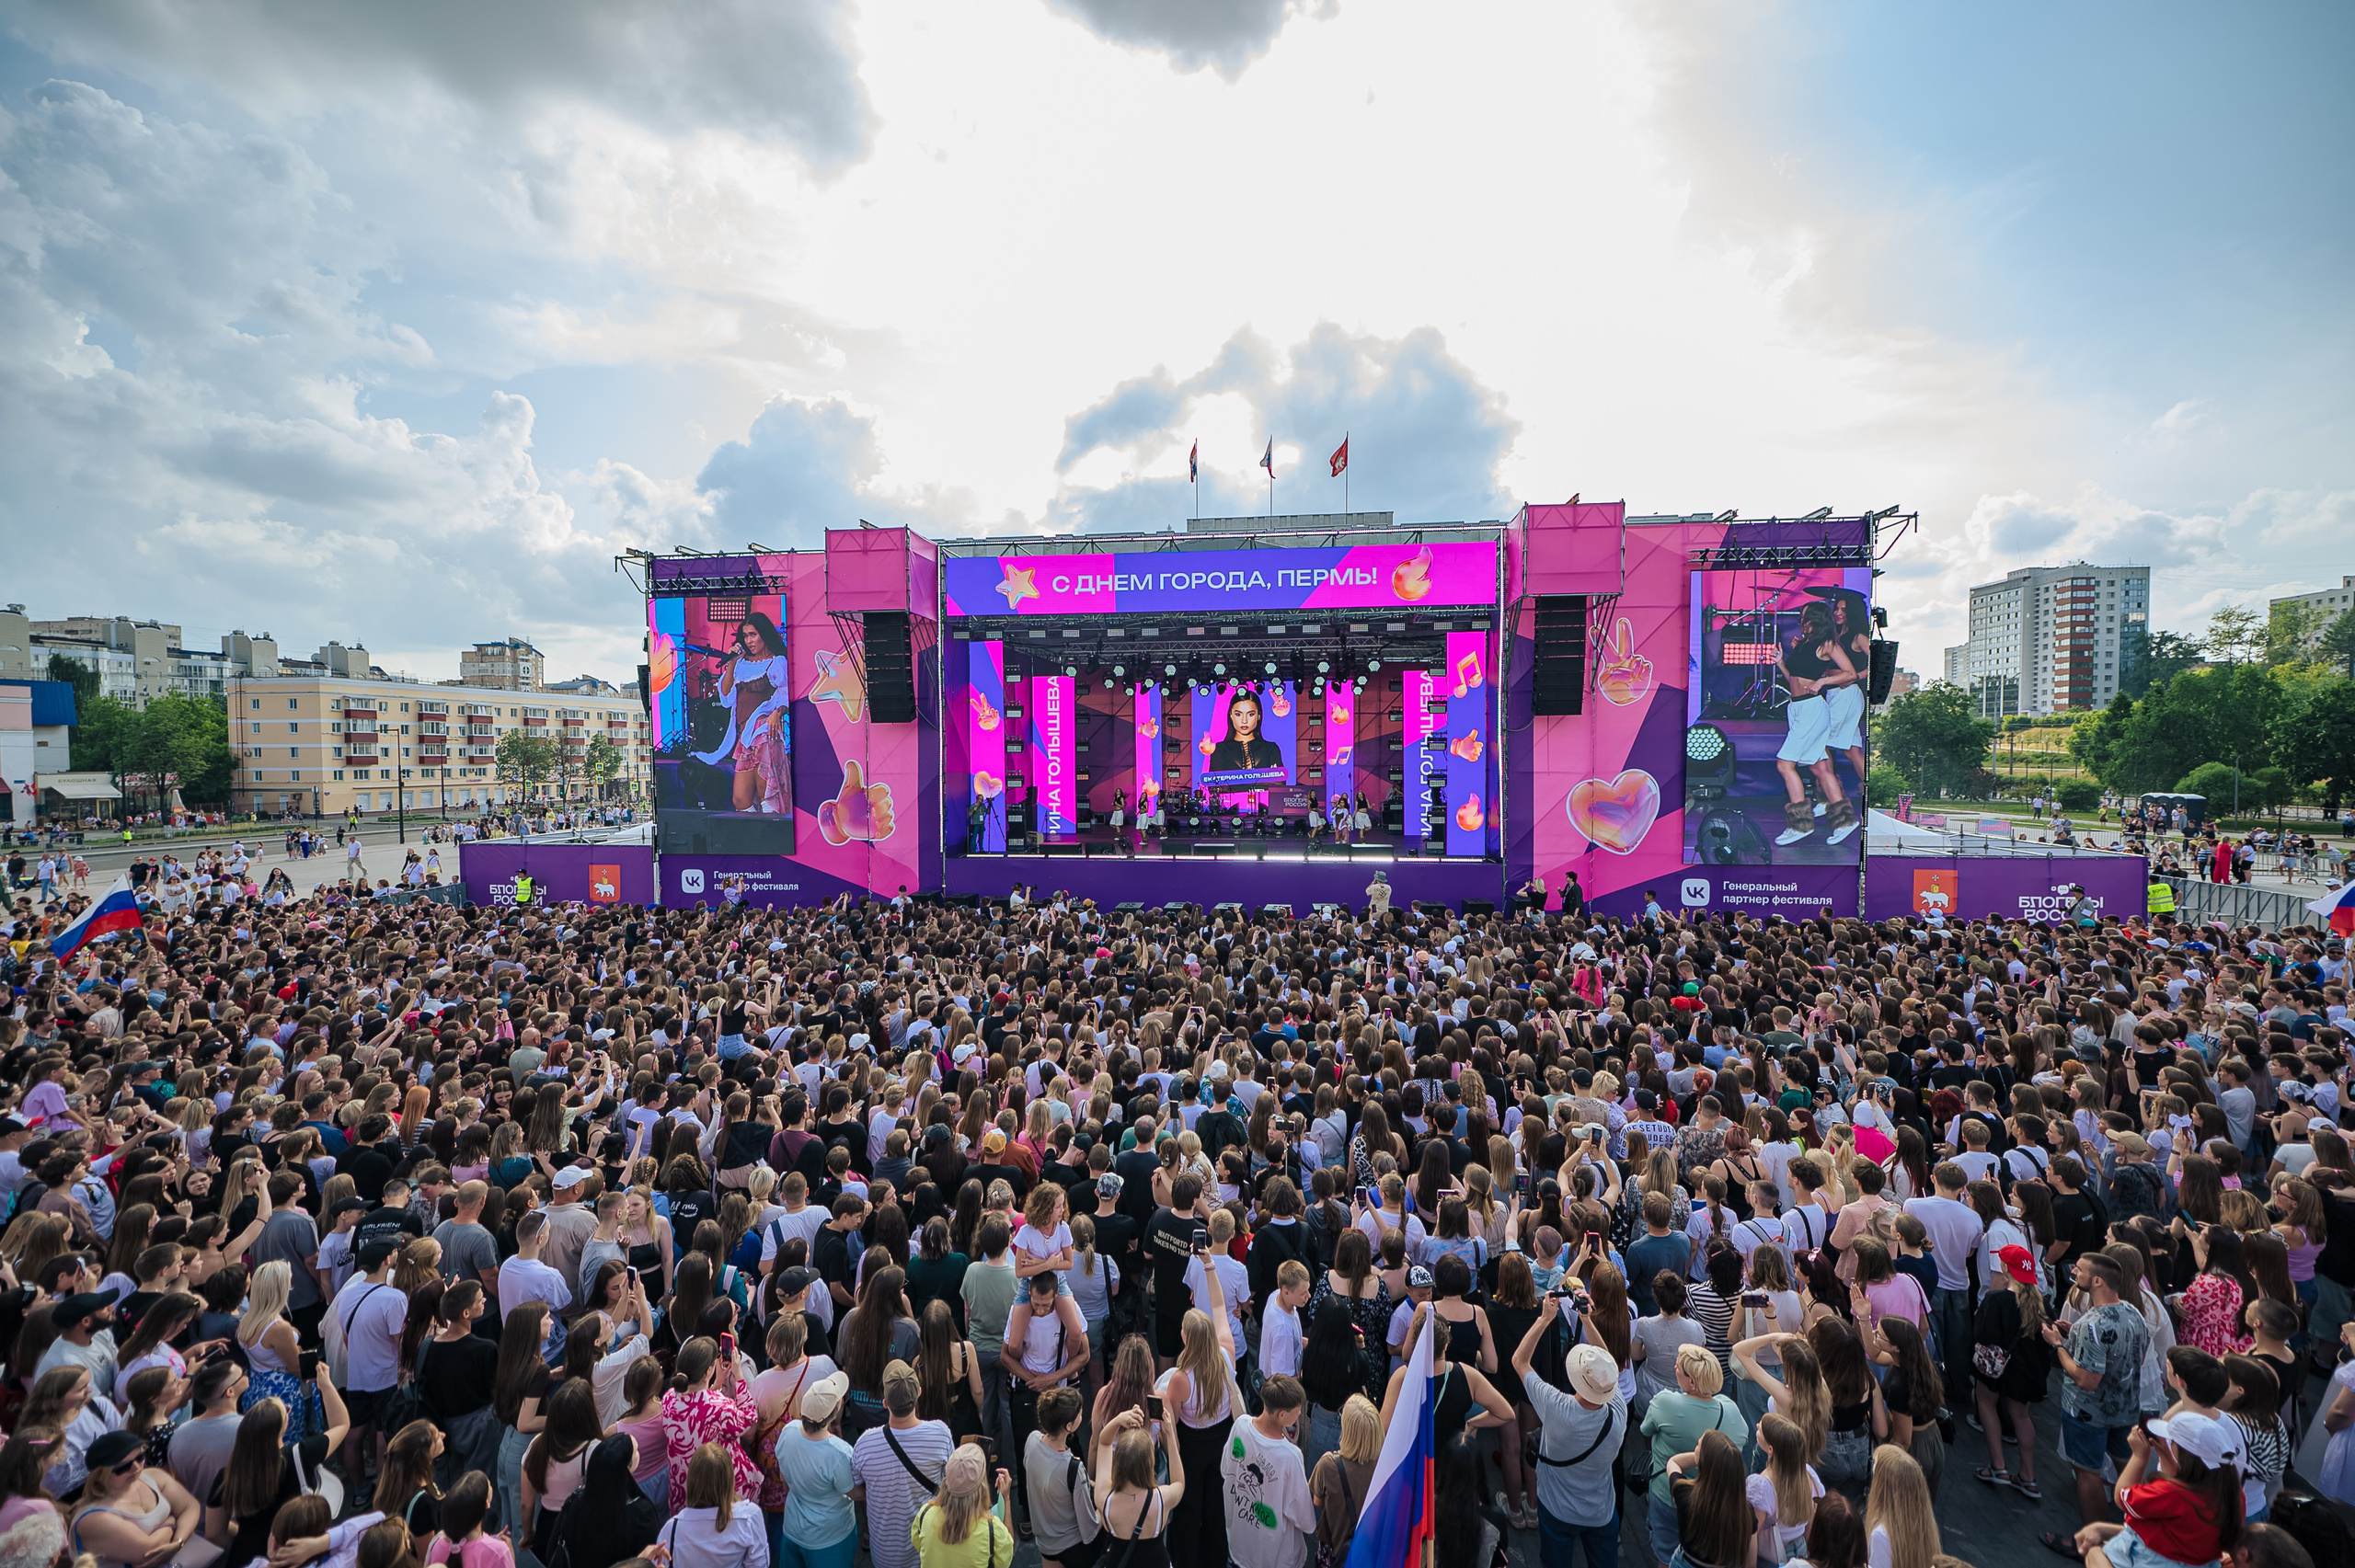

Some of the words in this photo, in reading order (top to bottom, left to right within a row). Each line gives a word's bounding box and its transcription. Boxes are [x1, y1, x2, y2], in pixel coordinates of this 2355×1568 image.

[1051, 575, 1070, 593] С
[1074, 573, 1153, 596] ДНЕМ
[1159, 570, 1271, 593] ГОРОДА,
[1277, 567, 1377, 587] ПЕРМЬ!
[1047, 676, 1061, 784] ГОЛЫШЕВА
[489, 884, 546, 895] БЛОГЫ
[752, 882, 798, 892] фестиваля
[1723, 881, 1798, 892] Генеральный
[493, 895, 543, 906] РОСИ
[1723, 896, 1769, 906] партнер
[1772, 896, 1832, 906] фестиваля
[2018, 896, 2104, 909] БЛОГЕЫ
[2024, 909, 2098, 921] РОС
[1238, 1508, 1260, 1529] CARE
